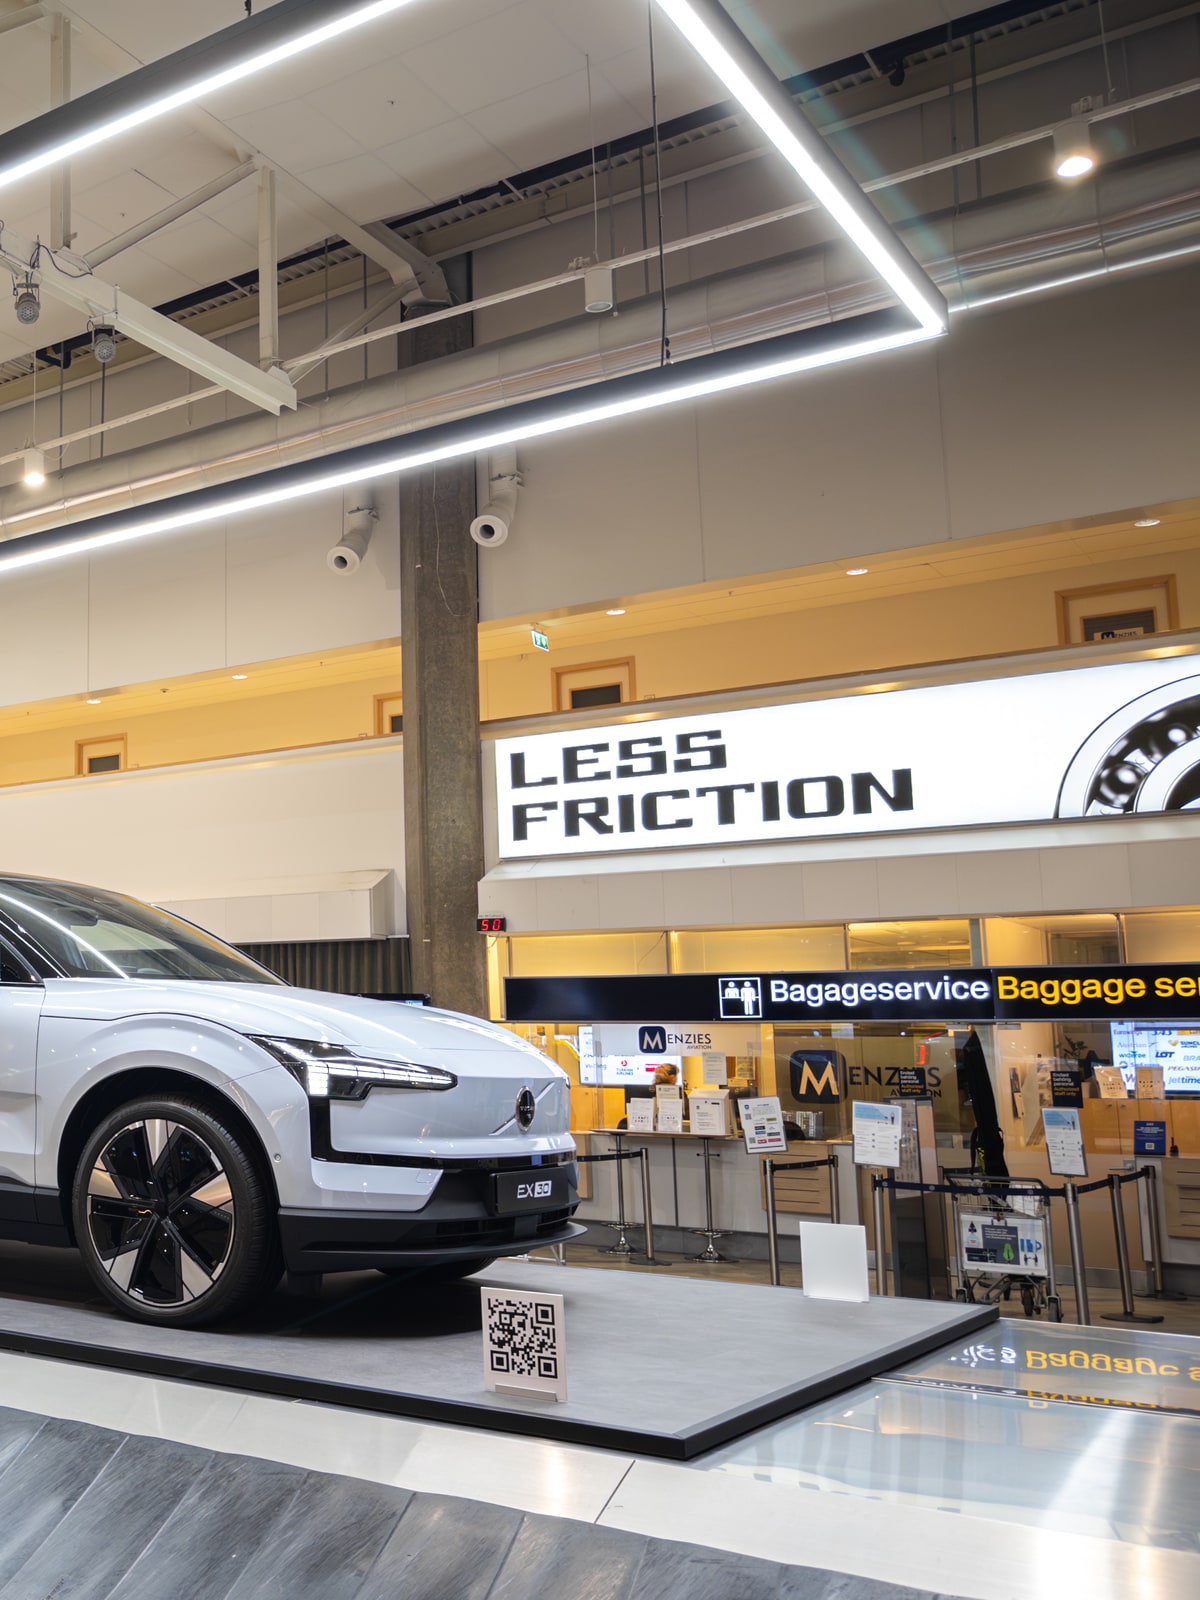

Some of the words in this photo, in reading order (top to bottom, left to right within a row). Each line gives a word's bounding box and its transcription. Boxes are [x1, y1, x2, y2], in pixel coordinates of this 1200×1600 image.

[510, 729, 727, 789] LESS
[512, 768, 913, 841] FRICTION
[481, 919, 502, 931] 50
[770, 975, 990, 1007] Bagageservice
[997, 975, 1147, 1005] Baggage
[642, 1029, 712, 1050] MENZIES
[798, 1060, 942, 1096] MENZS
[517, 1180, 552, 1199] EX30
